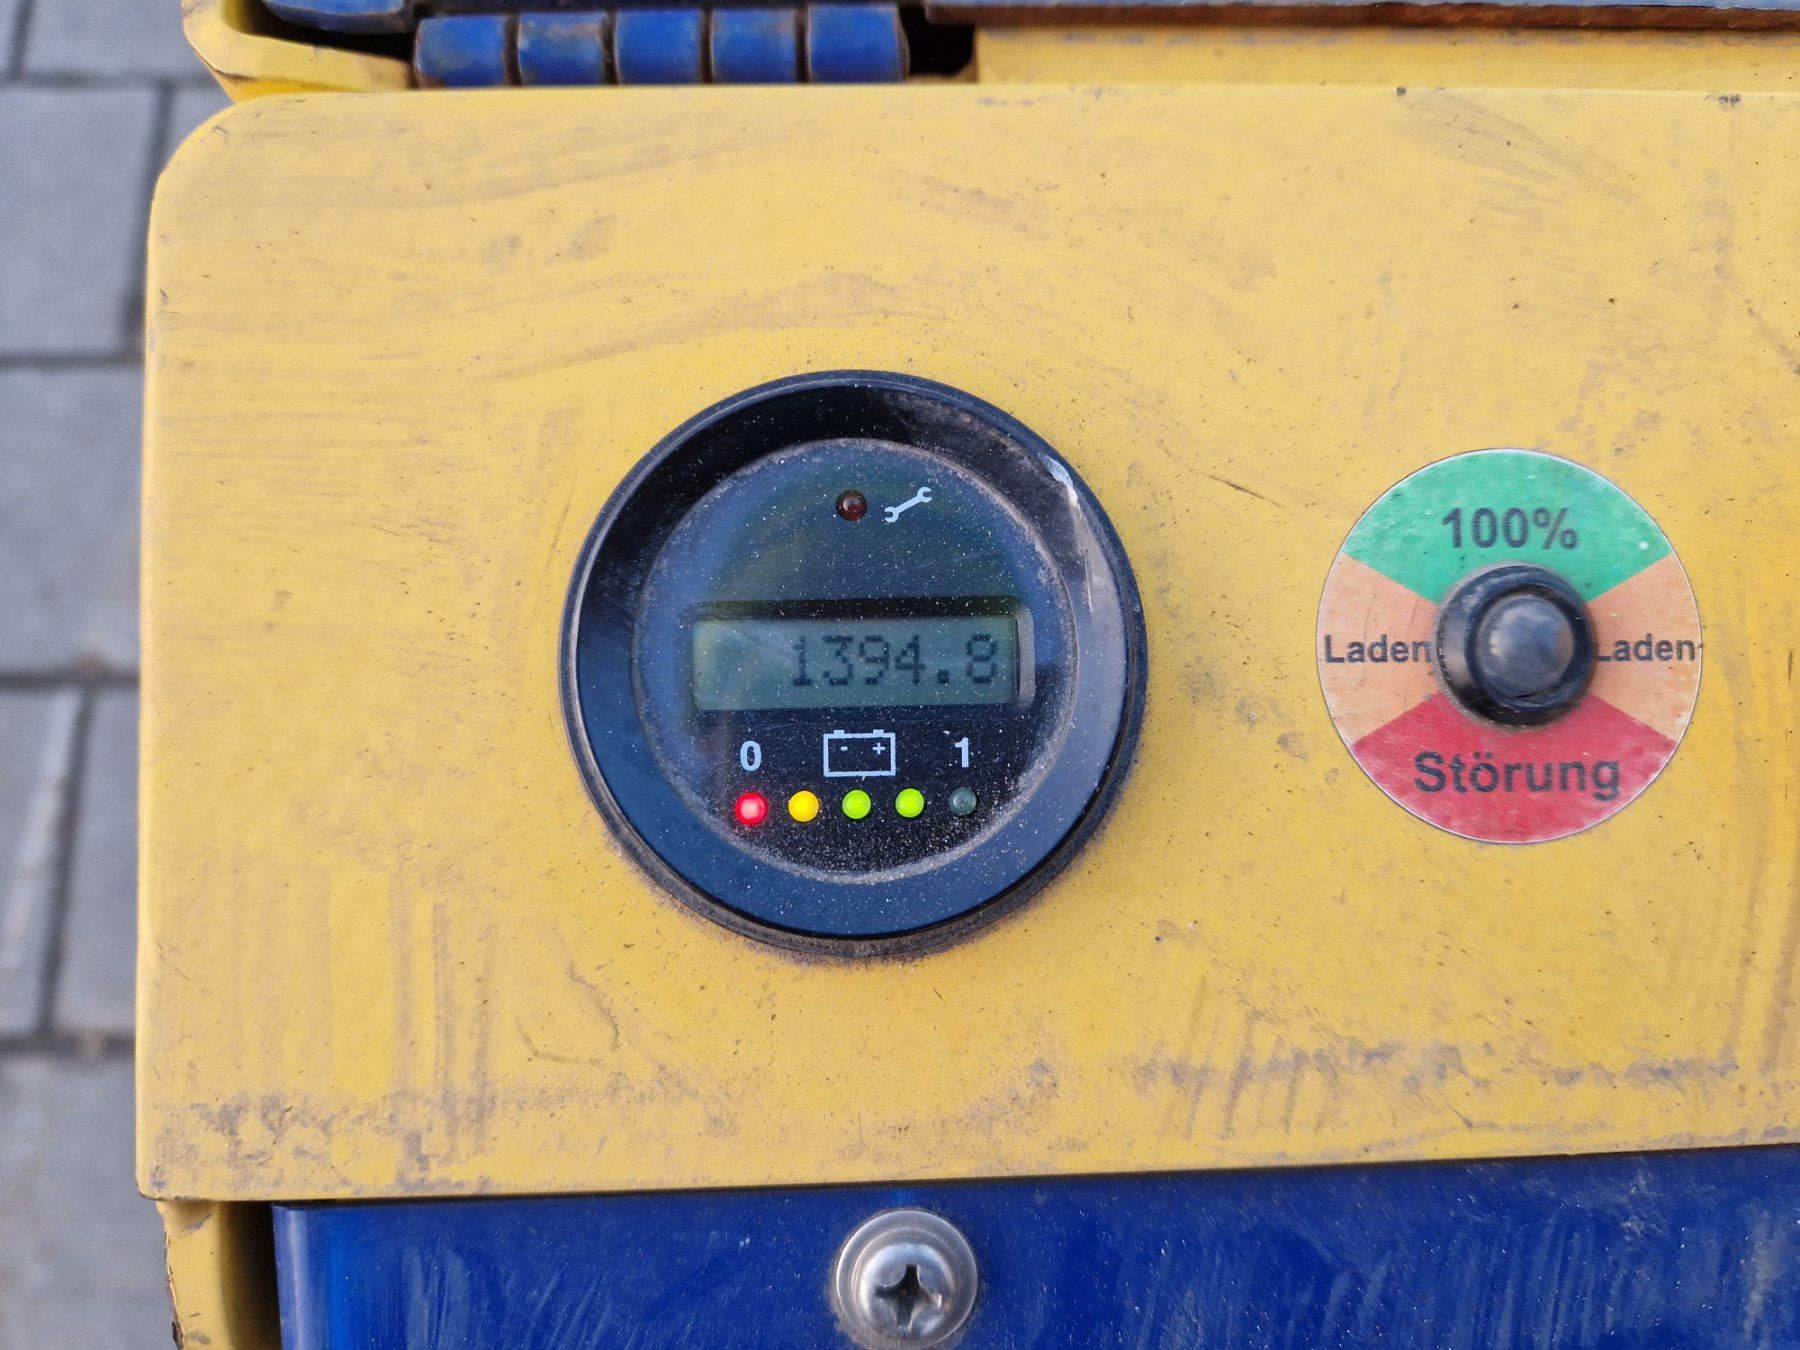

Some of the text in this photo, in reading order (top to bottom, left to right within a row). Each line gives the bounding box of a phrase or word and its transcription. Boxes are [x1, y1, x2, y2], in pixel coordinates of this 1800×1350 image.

[1441, 507, 1578, 550] 100%
[792, 635, 999, 685] 1394.8
[1324, 634, 1432, 663] Laden
[740, 740, 762, 771] 0
[953, 738, 971, 769] 1
[1414, 751, 1620, 801] Störung
